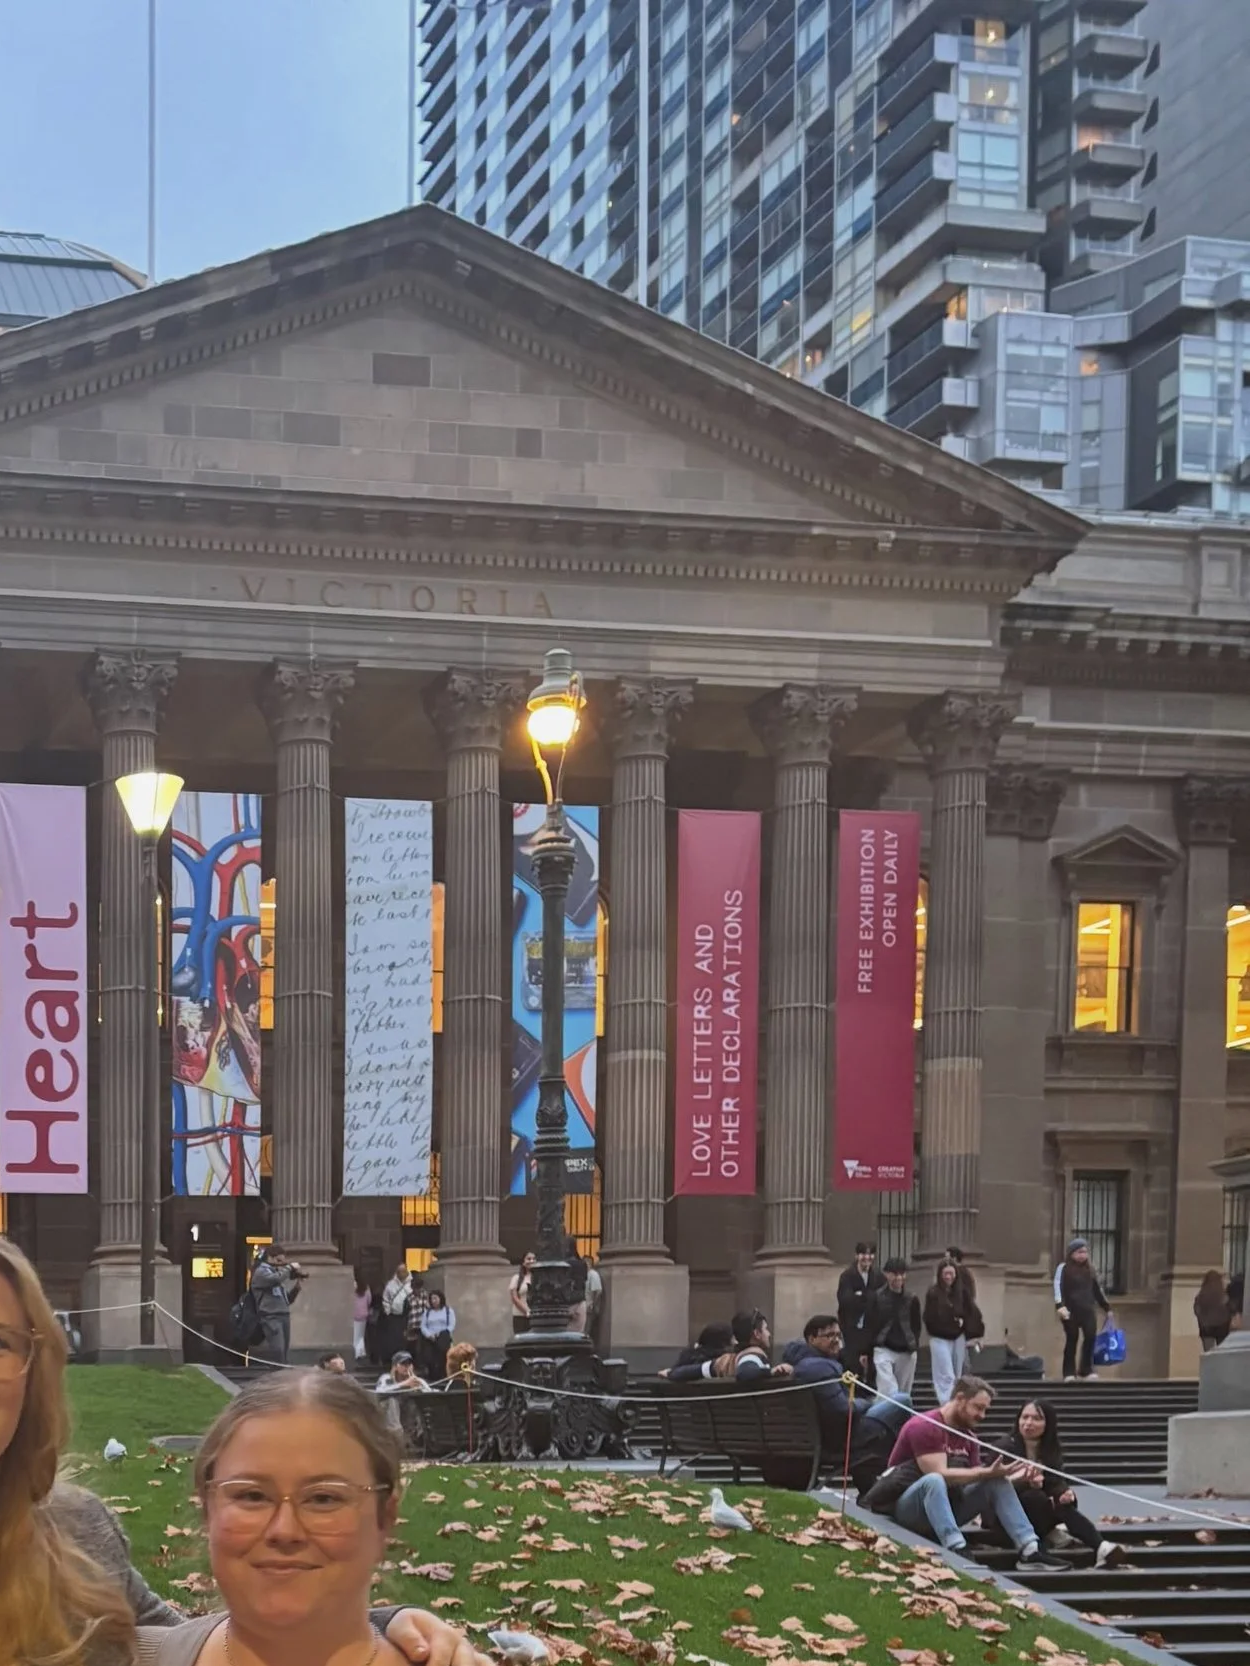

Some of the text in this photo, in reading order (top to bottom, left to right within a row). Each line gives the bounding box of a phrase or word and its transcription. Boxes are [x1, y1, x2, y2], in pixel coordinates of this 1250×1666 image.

[239, 574, 554, 618] VICTORIA
[858, 829, 875, 993] FREE EXHIBITION
[882, 830, 898, 947] OPEN DAILY
[5, 900, 81, 1174] Heart
[692, 923, 714, 1177] LOVE LETTERS AND
[720, 889, 743, 1178] OTHER DECLARATIONS
